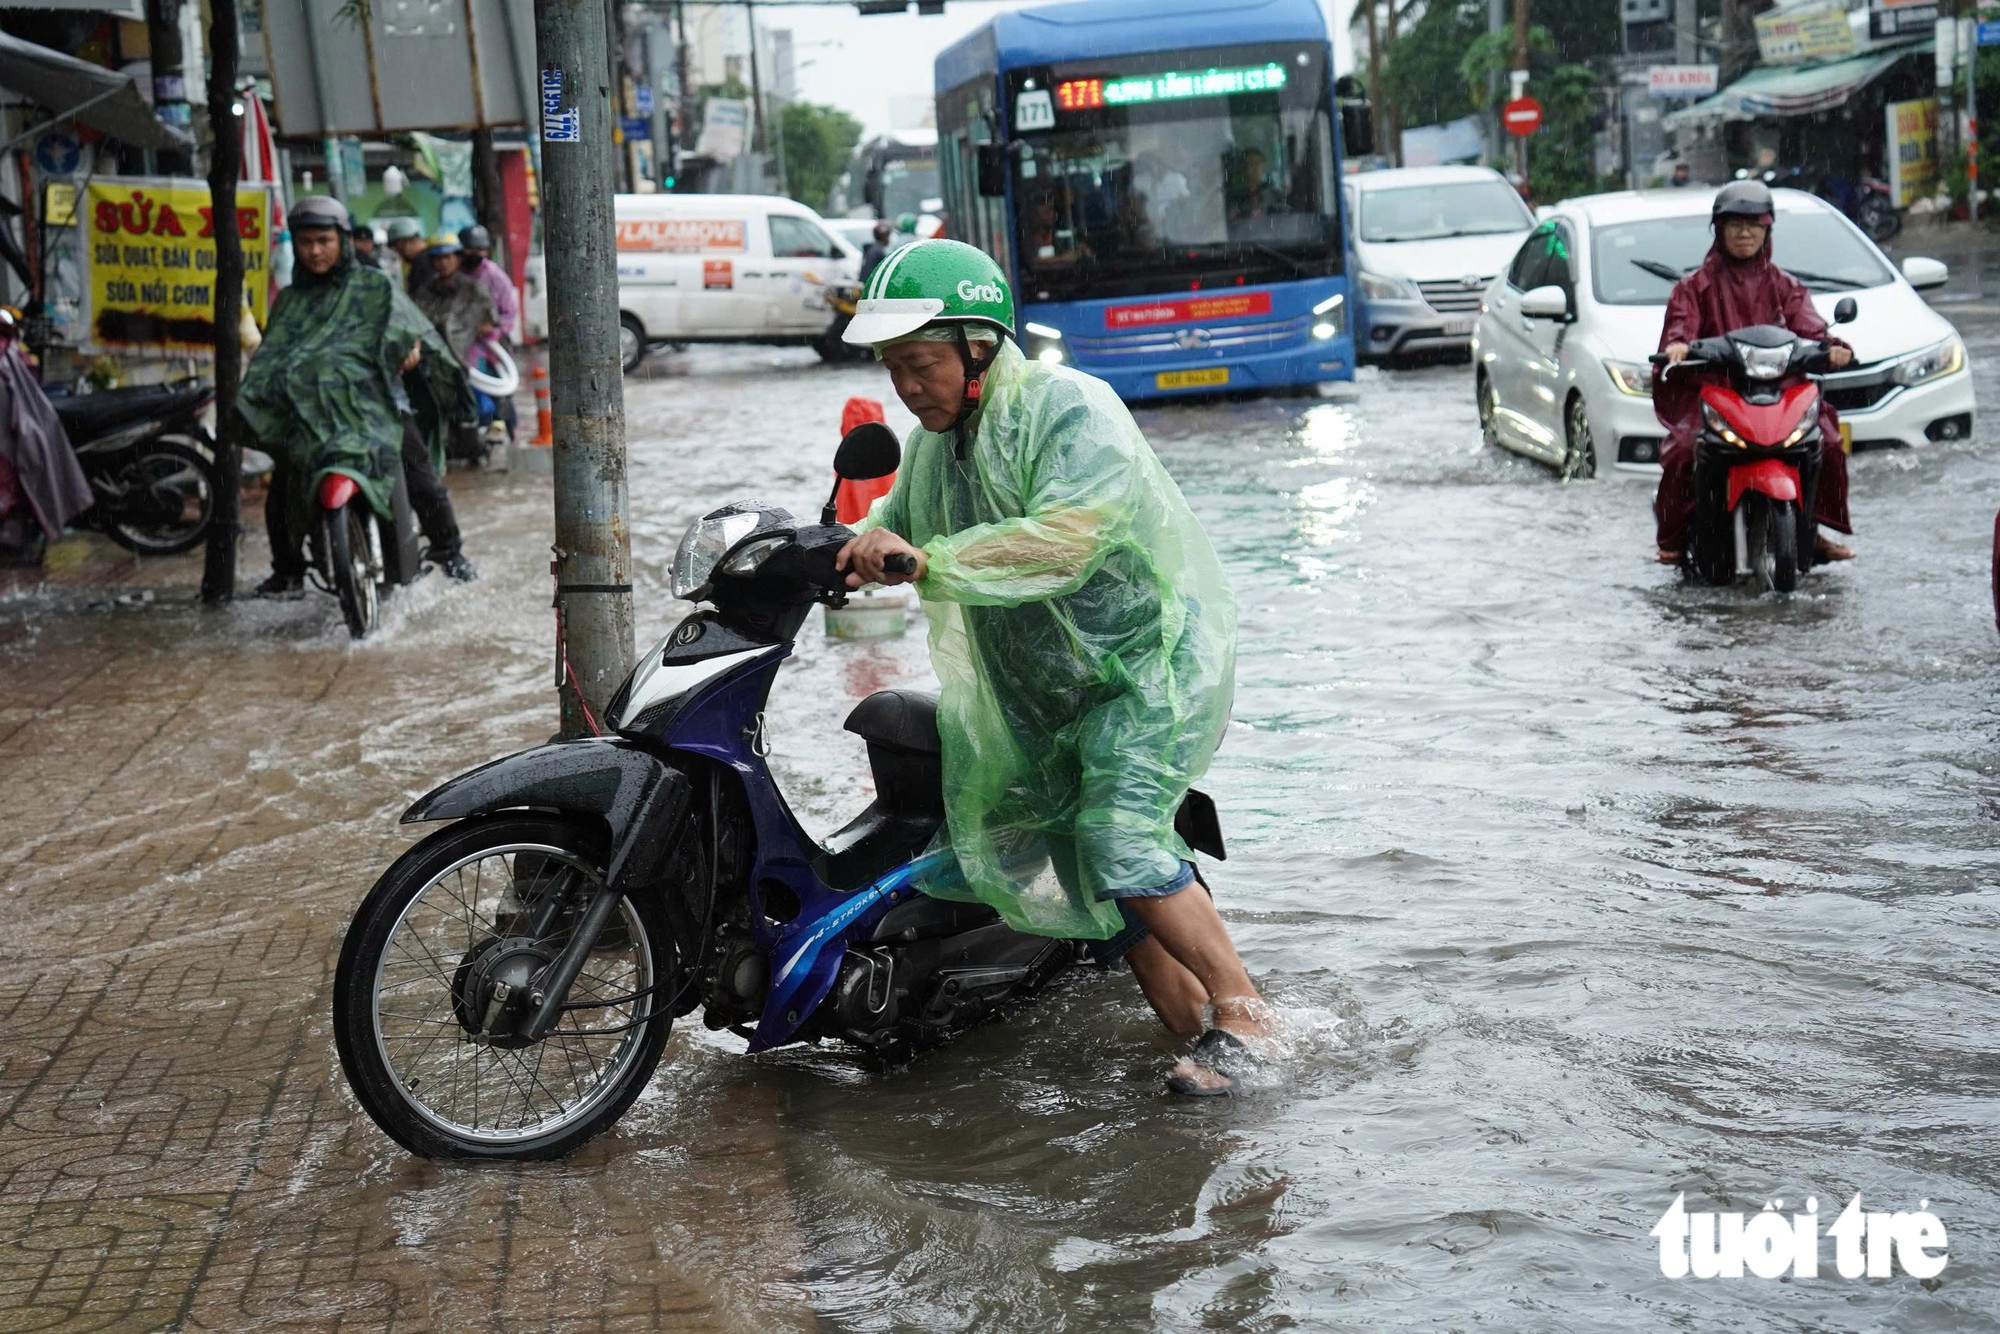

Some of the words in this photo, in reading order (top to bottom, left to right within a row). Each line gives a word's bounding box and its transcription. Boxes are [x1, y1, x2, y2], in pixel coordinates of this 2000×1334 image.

[1059, 79, 1101, 108] 171
[1021, 102, 1049, 122] 171
[95, 191, 186, 237] SỬA
[623, 221, 741, 243] LALAMOVE
[957, 279, 1004, 304] Grab
[814, 890, 876, 940] 4-STROKE
